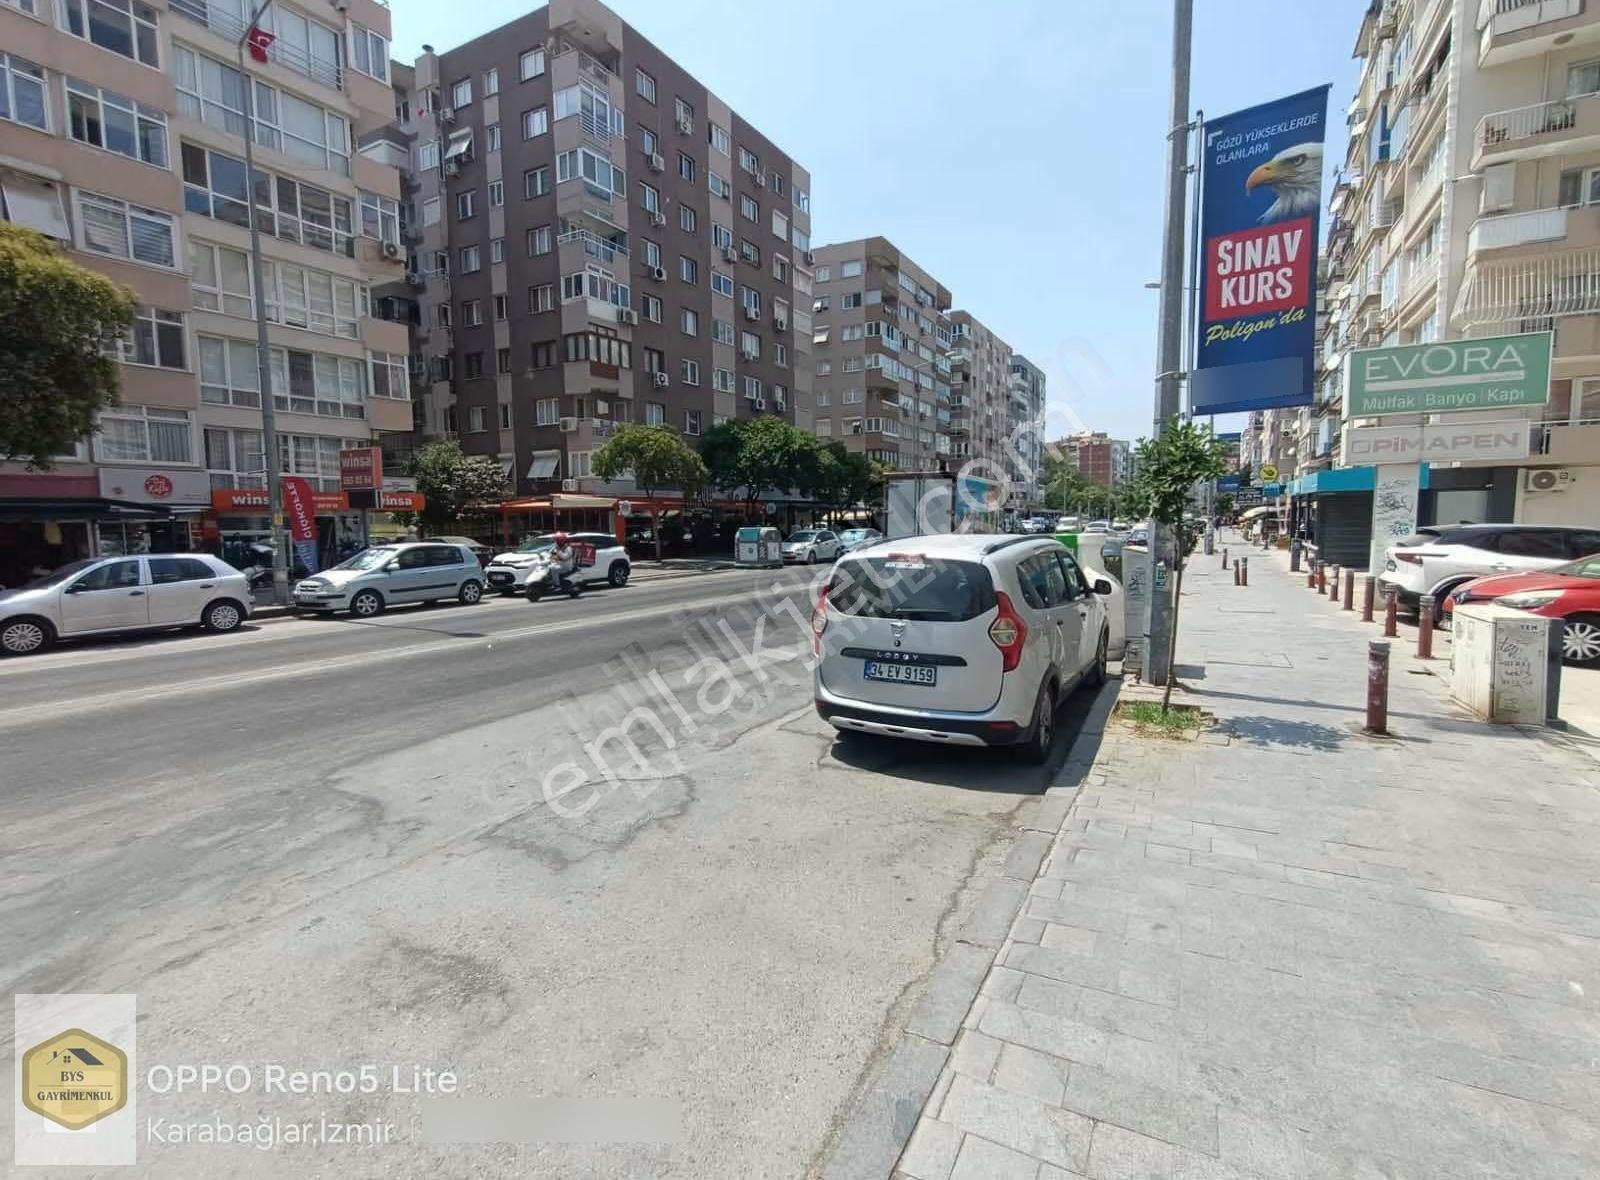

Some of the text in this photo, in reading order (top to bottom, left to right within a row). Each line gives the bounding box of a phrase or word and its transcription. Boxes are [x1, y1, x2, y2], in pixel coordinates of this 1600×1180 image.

[1216, 113, 1319, 151] GÖZÜ YÜKSEKLERDE
[1216, 142, 1269, 165] OLANLARA
[1217, 229, 1303, 276] SINAV
[1220, 267, 1293, 308] KURS
[1204, 305, 1306, 347] Poligon'da
[1365, 344, 1526, 381] EVORA
[1426, 391, 1476, 408] Banyo
[341, 453, 372, 468] winsa
[231, 493, 273, 505] wins
[872, 663, 932, 681] 34 EV 9159
